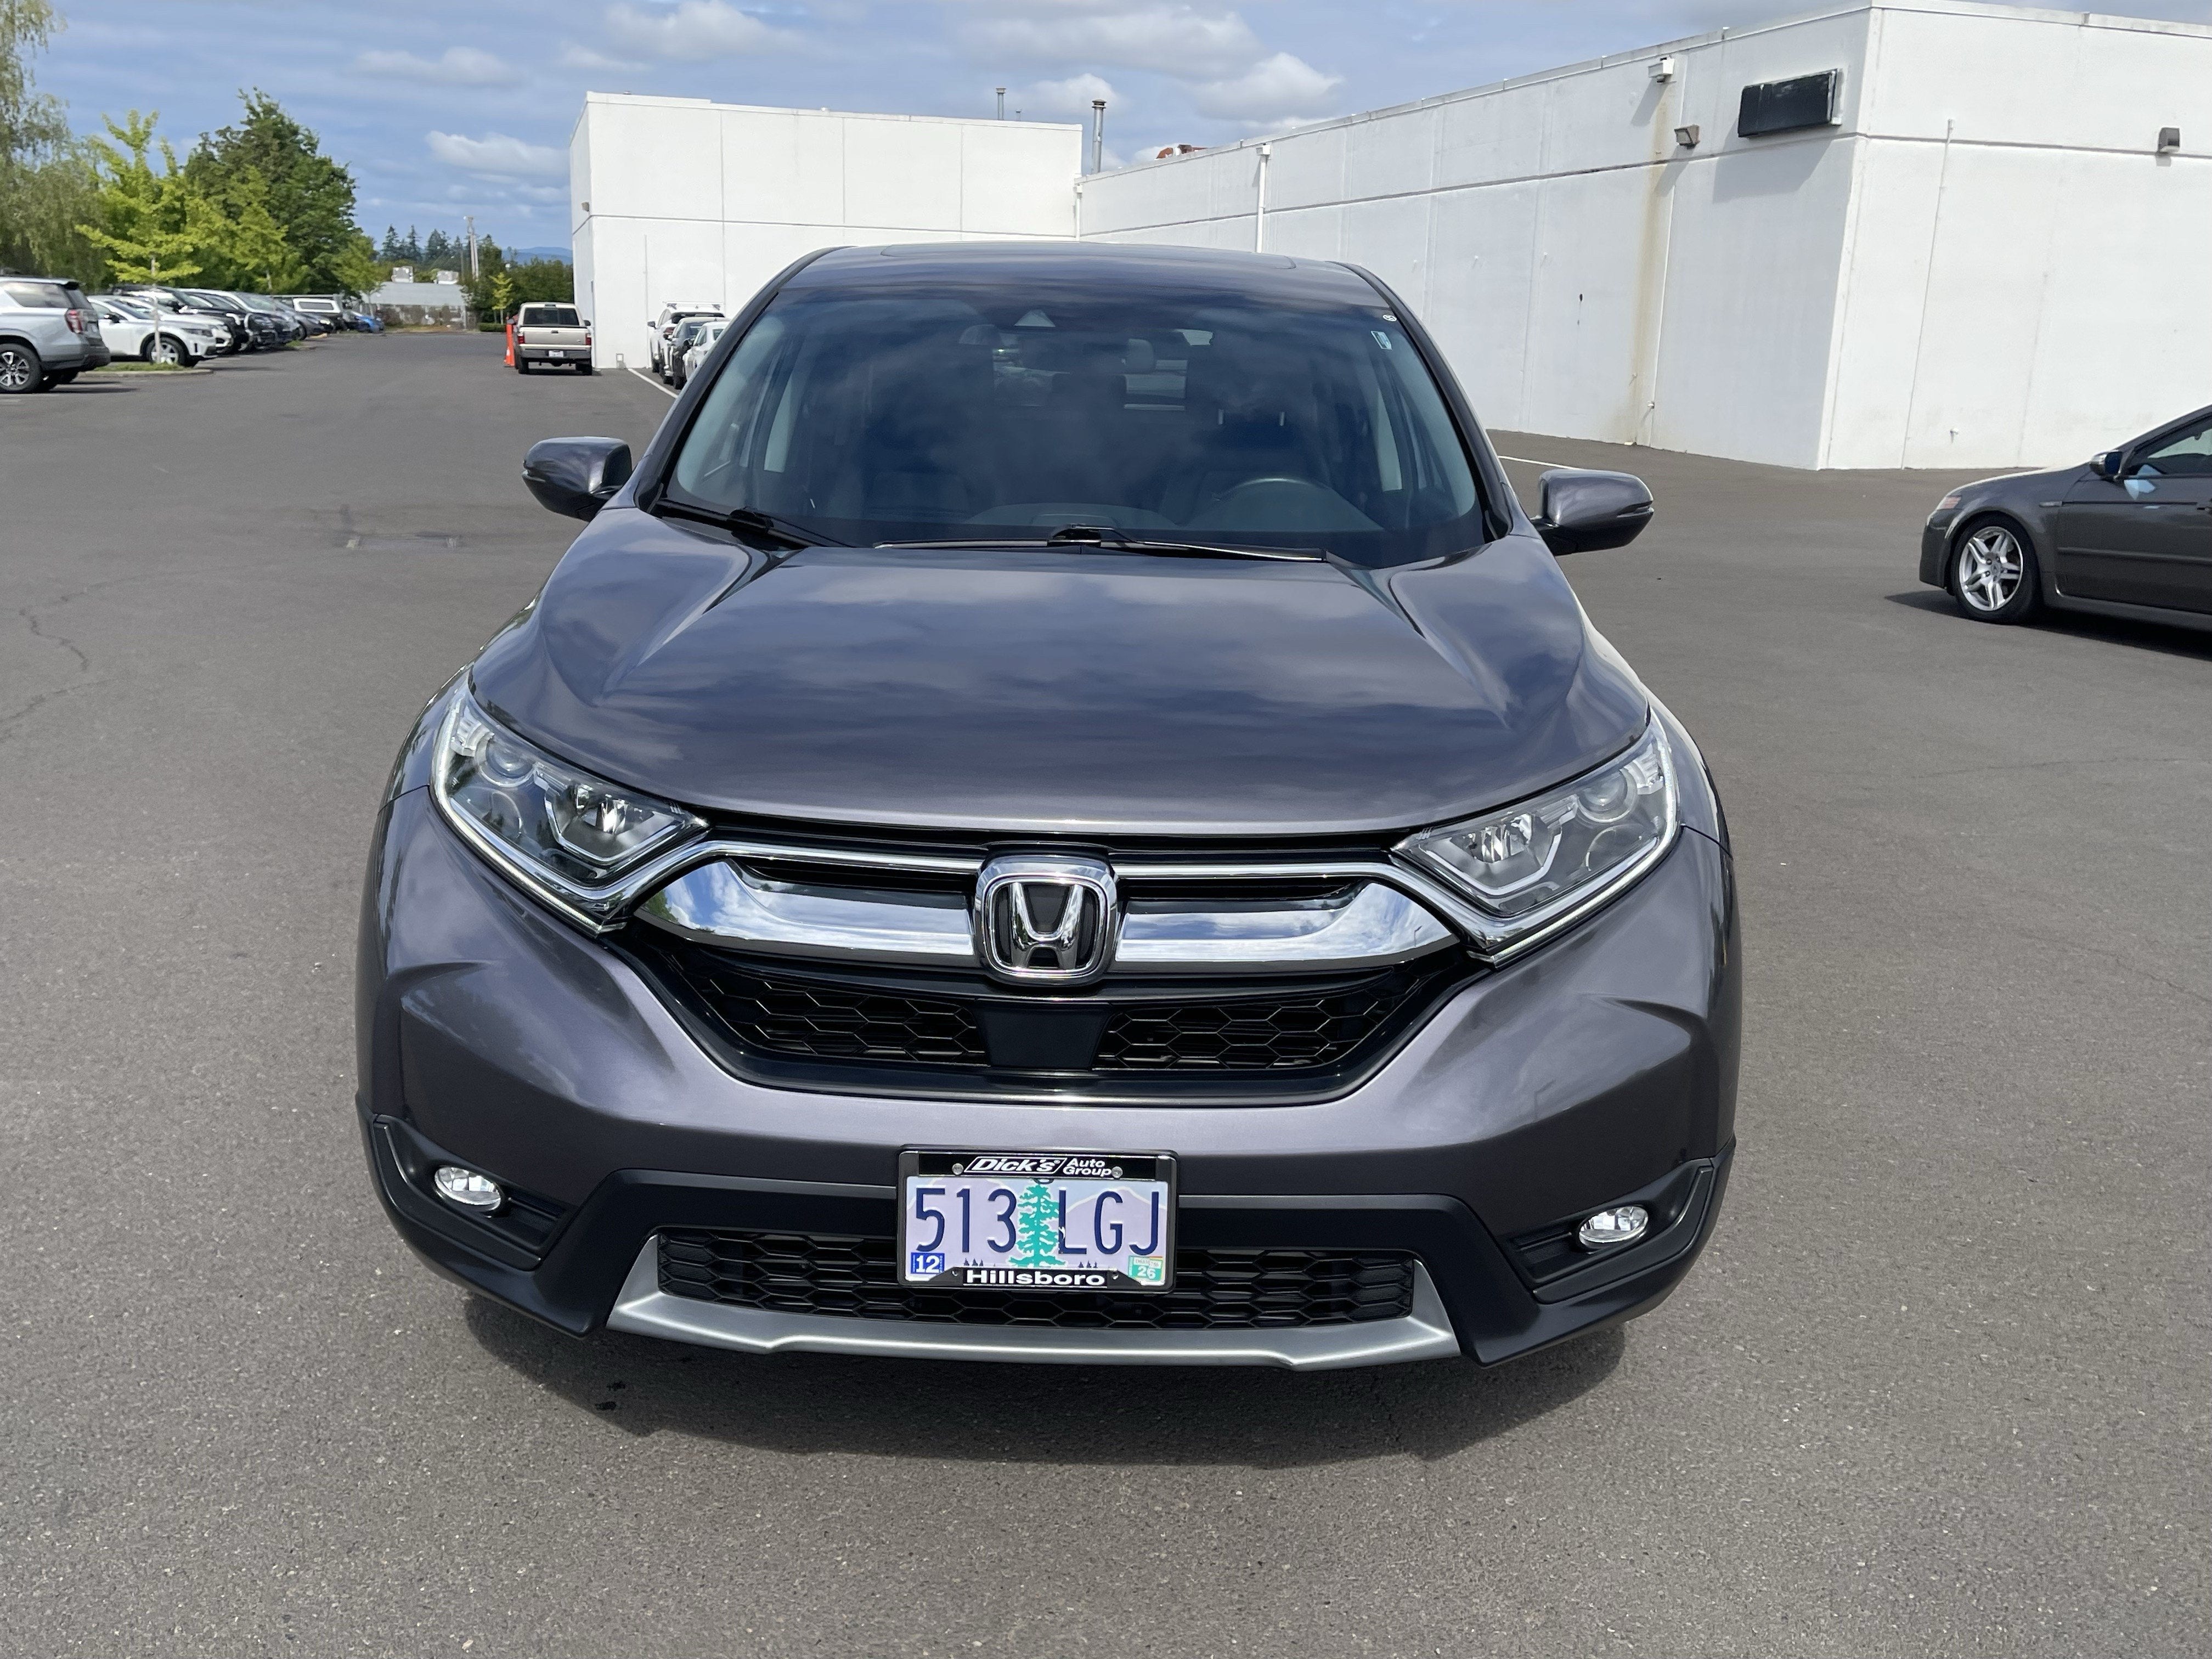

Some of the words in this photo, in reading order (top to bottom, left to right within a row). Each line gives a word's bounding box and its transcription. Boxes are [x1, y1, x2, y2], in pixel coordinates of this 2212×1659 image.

[971, 1158, 1056, 1172] Dick's
[1066, 1158, 1105, 1167] Auto
[1063, 1166, 1112, 1177] Group
[915, 1187, 1017, 1253] 513
[1058, 1189, 1160, 1255] LGJ
[916, 1255, 940, 1273] 12
[967, 1269, 1105, 1285] Hillsboro
[1137, 1266, 1156, 1279] 26
